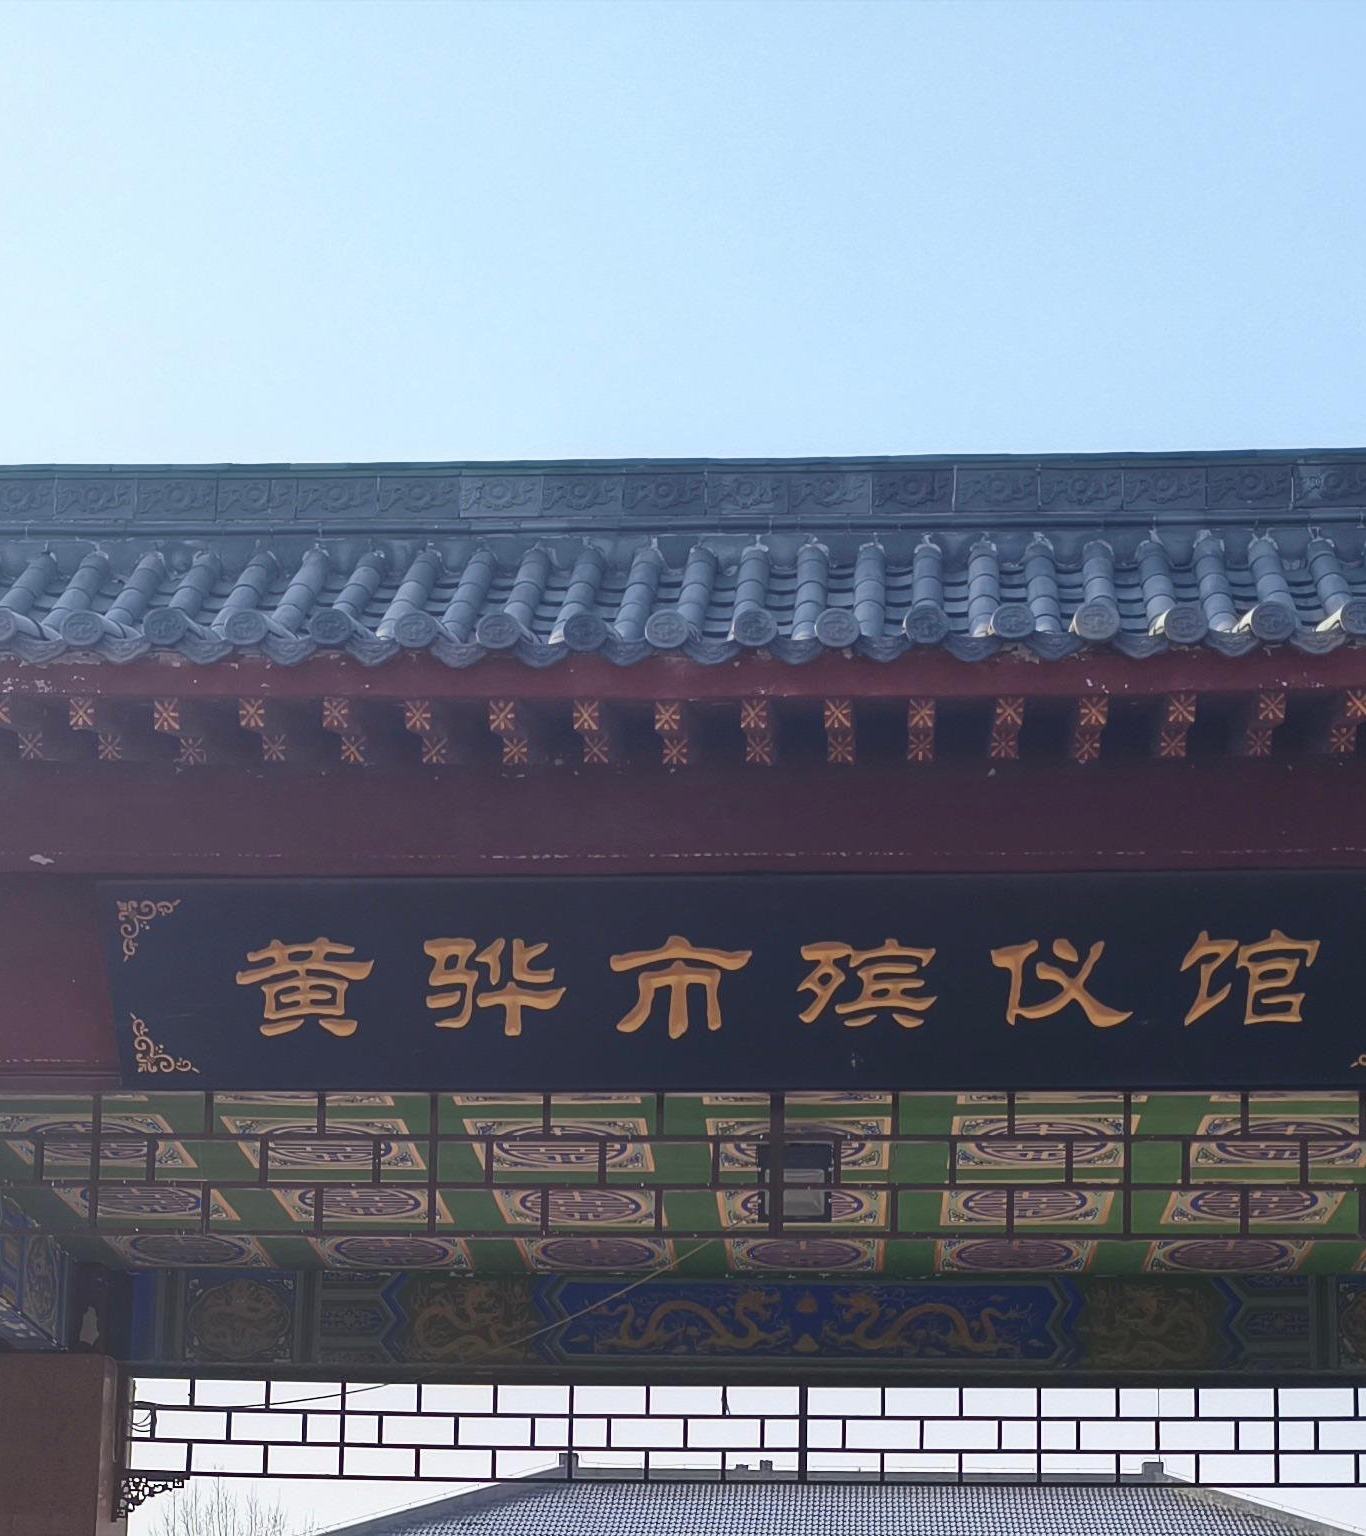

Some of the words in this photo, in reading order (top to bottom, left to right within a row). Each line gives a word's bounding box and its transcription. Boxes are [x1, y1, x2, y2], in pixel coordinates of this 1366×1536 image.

[235, 928, 1321, 1038] 黄骅市殡仪馆
